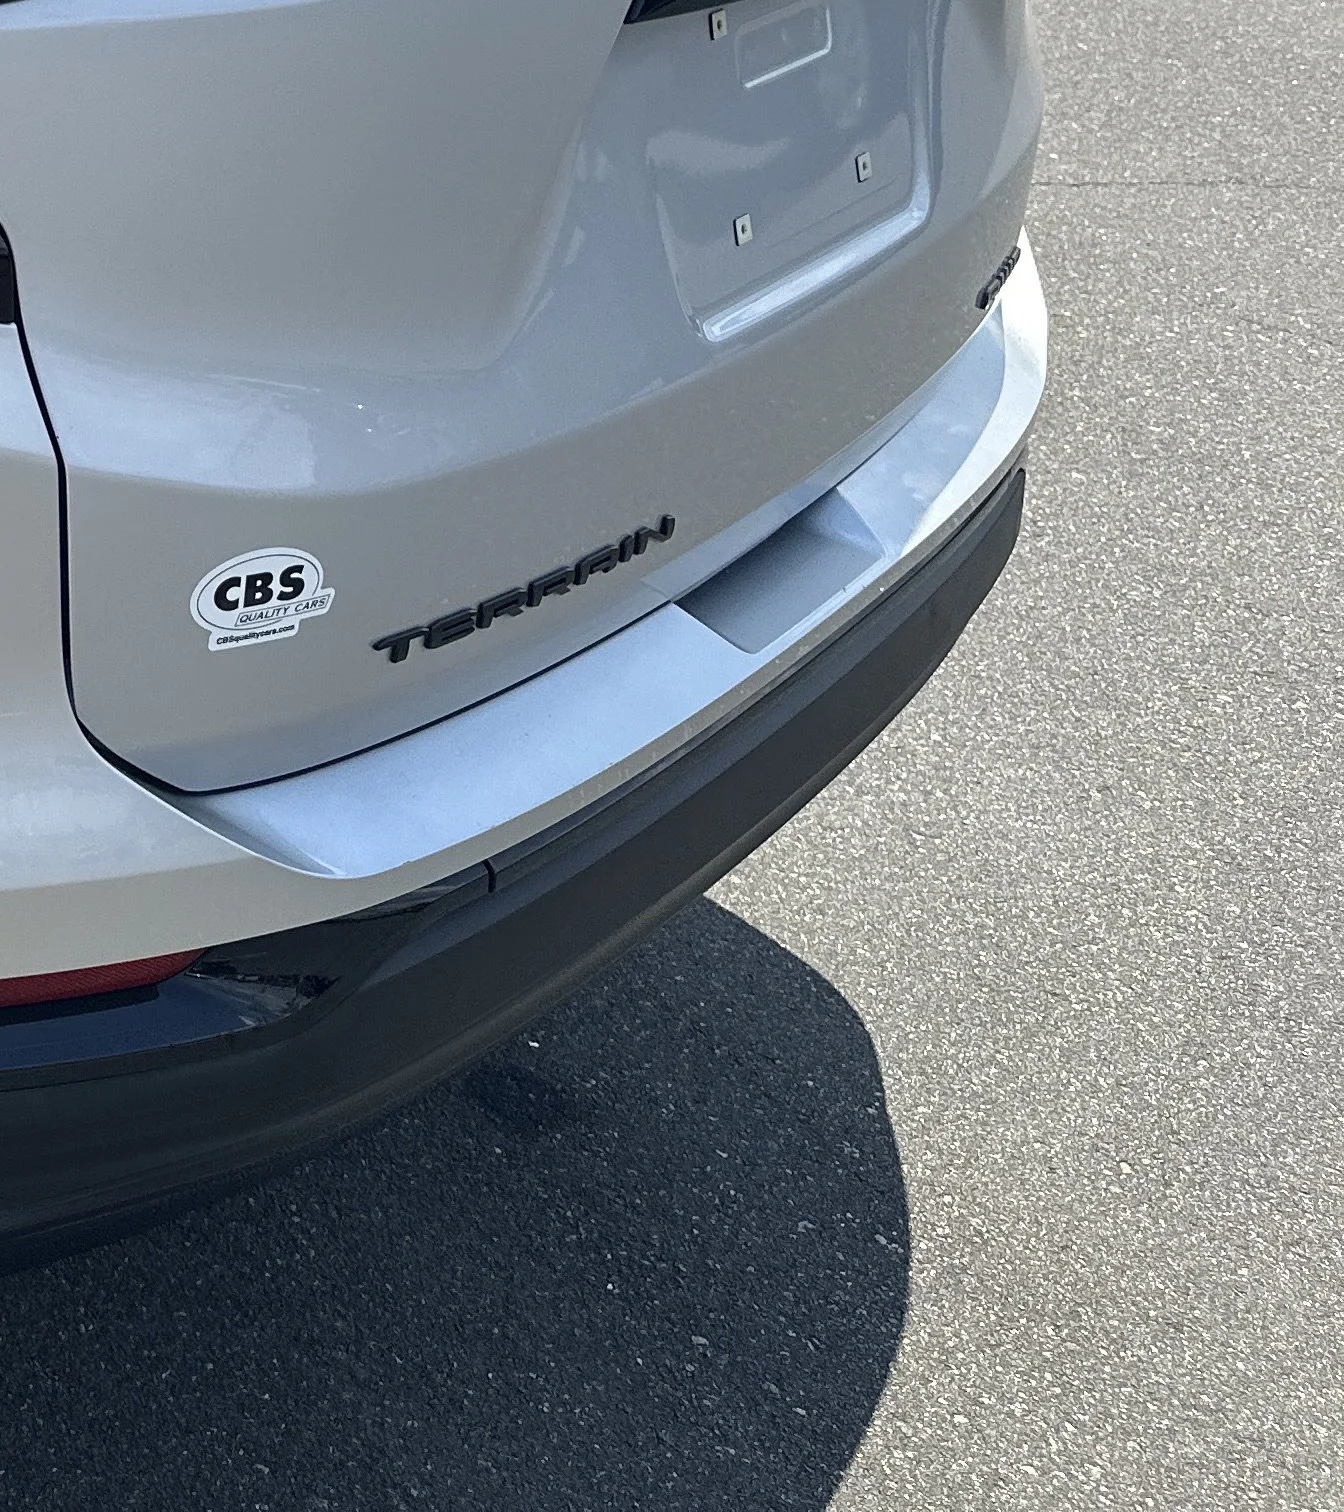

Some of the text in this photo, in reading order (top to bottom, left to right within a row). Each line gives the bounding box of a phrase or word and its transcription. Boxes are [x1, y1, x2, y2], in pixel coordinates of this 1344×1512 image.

[213, 564, 305, 612] CBS
[372, 513, 676, 665] TERRAIN
[239, 597, 327, 624] QUALITY CARS
[216, 624, 295, 645] CBSqualitycars.com
